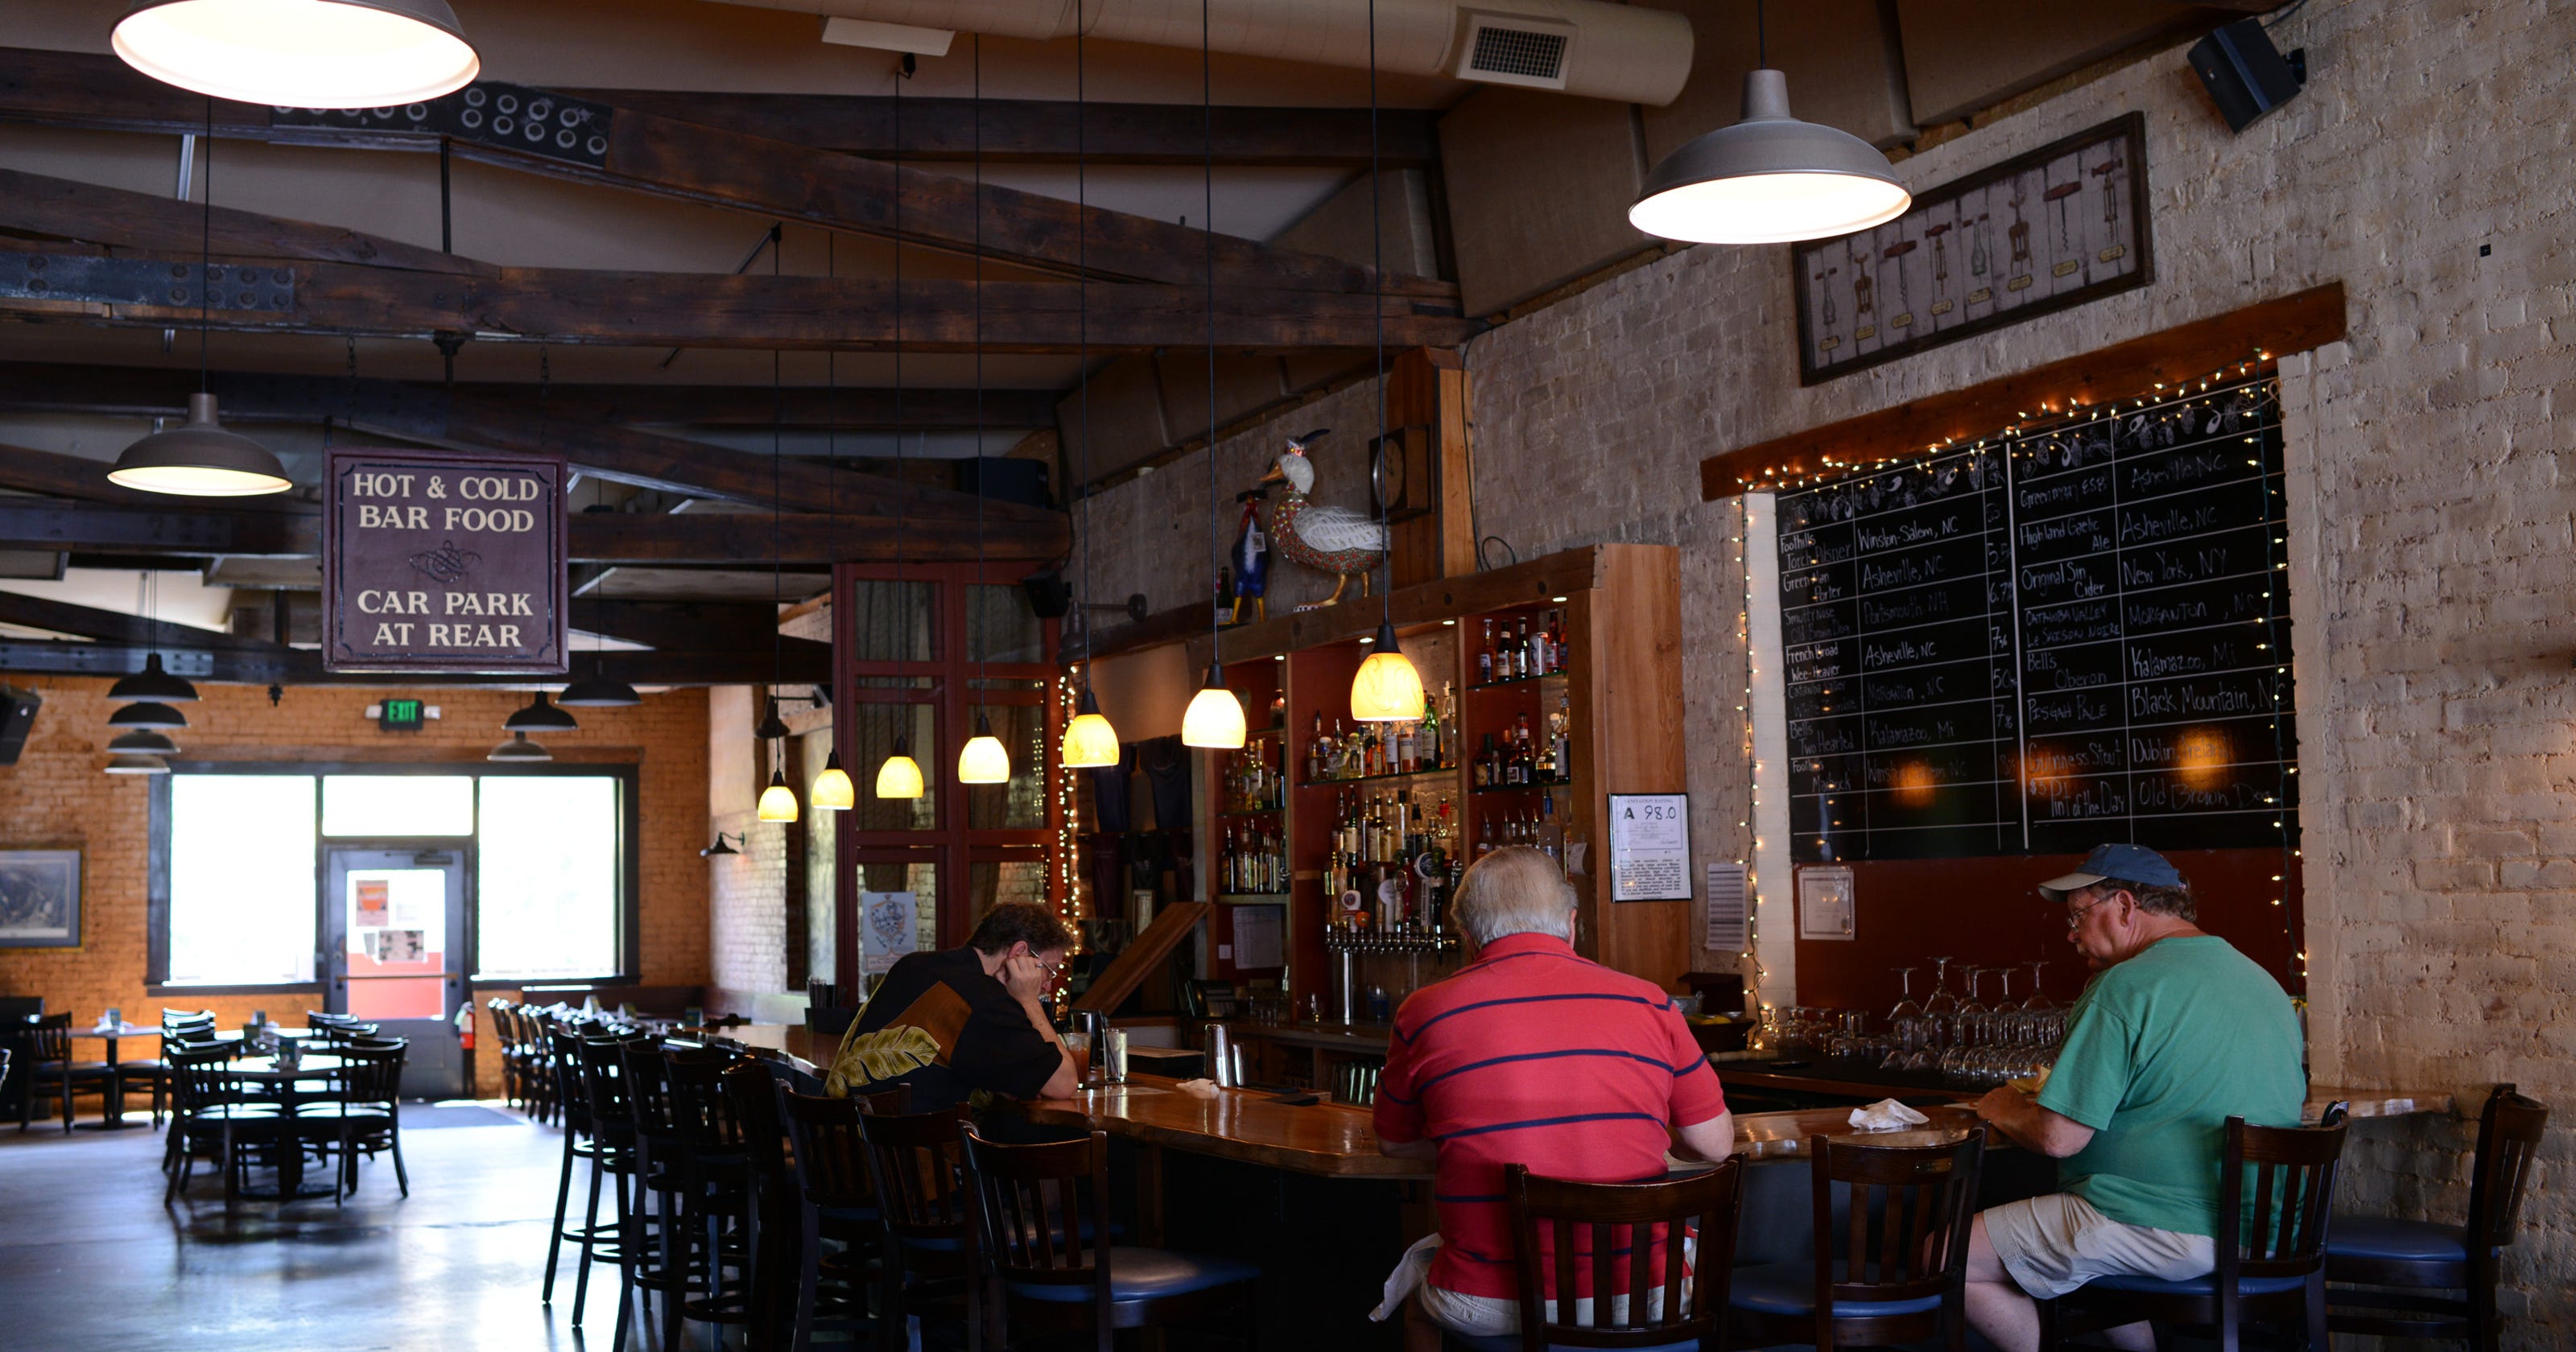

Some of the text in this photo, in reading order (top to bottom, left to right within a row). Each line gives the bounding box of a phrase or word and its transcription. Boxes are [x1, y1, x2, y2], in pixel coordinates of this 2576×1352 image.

[353, 473, 539, 501] HOT & COLD
[359, 505, 534, 532] BAR FOOD
[1942, 516, 1958, 534] NC
[2121, 506, 2218, 542] Asheville, NC
[1780, 532, 1816, 554] Foothills
[2020, 521, 2066, 550] Highland
[2092, 535, 2112, 551] Ale
[1863, 554, 1945, 590] Asheville, NC
[2021, 561, 2087, 597] Original Sin
[2122, 558, 2153, 586] New
[2198, 548, 2227, 575] NY
[1783, 574, 1810, 592] Green
[2074, 575, 2107, 599] Cider
[357, 590, 533, 617] CAR PARK
[373, 623, 522, 647] AT REAR
[1785, 646, 1814, 666] French
[1864, 640, 1938, 667] Asheville, NC
[2054, 668, 2107, 689] Oberon
[388, 700, 417, 721] EXIT
[2132, 686, 2177, 717] Black
[2182, 681, 2256, 715] Mountain,
[1799, 738, 1817, 755] Two
[2028, 738, 2123, 773] Guinness Stout
[2100, 781, 2125, 815] Day
[2139, 777, 2166, 807] Old
[1624, 806, 1676, 820] A 98.0
